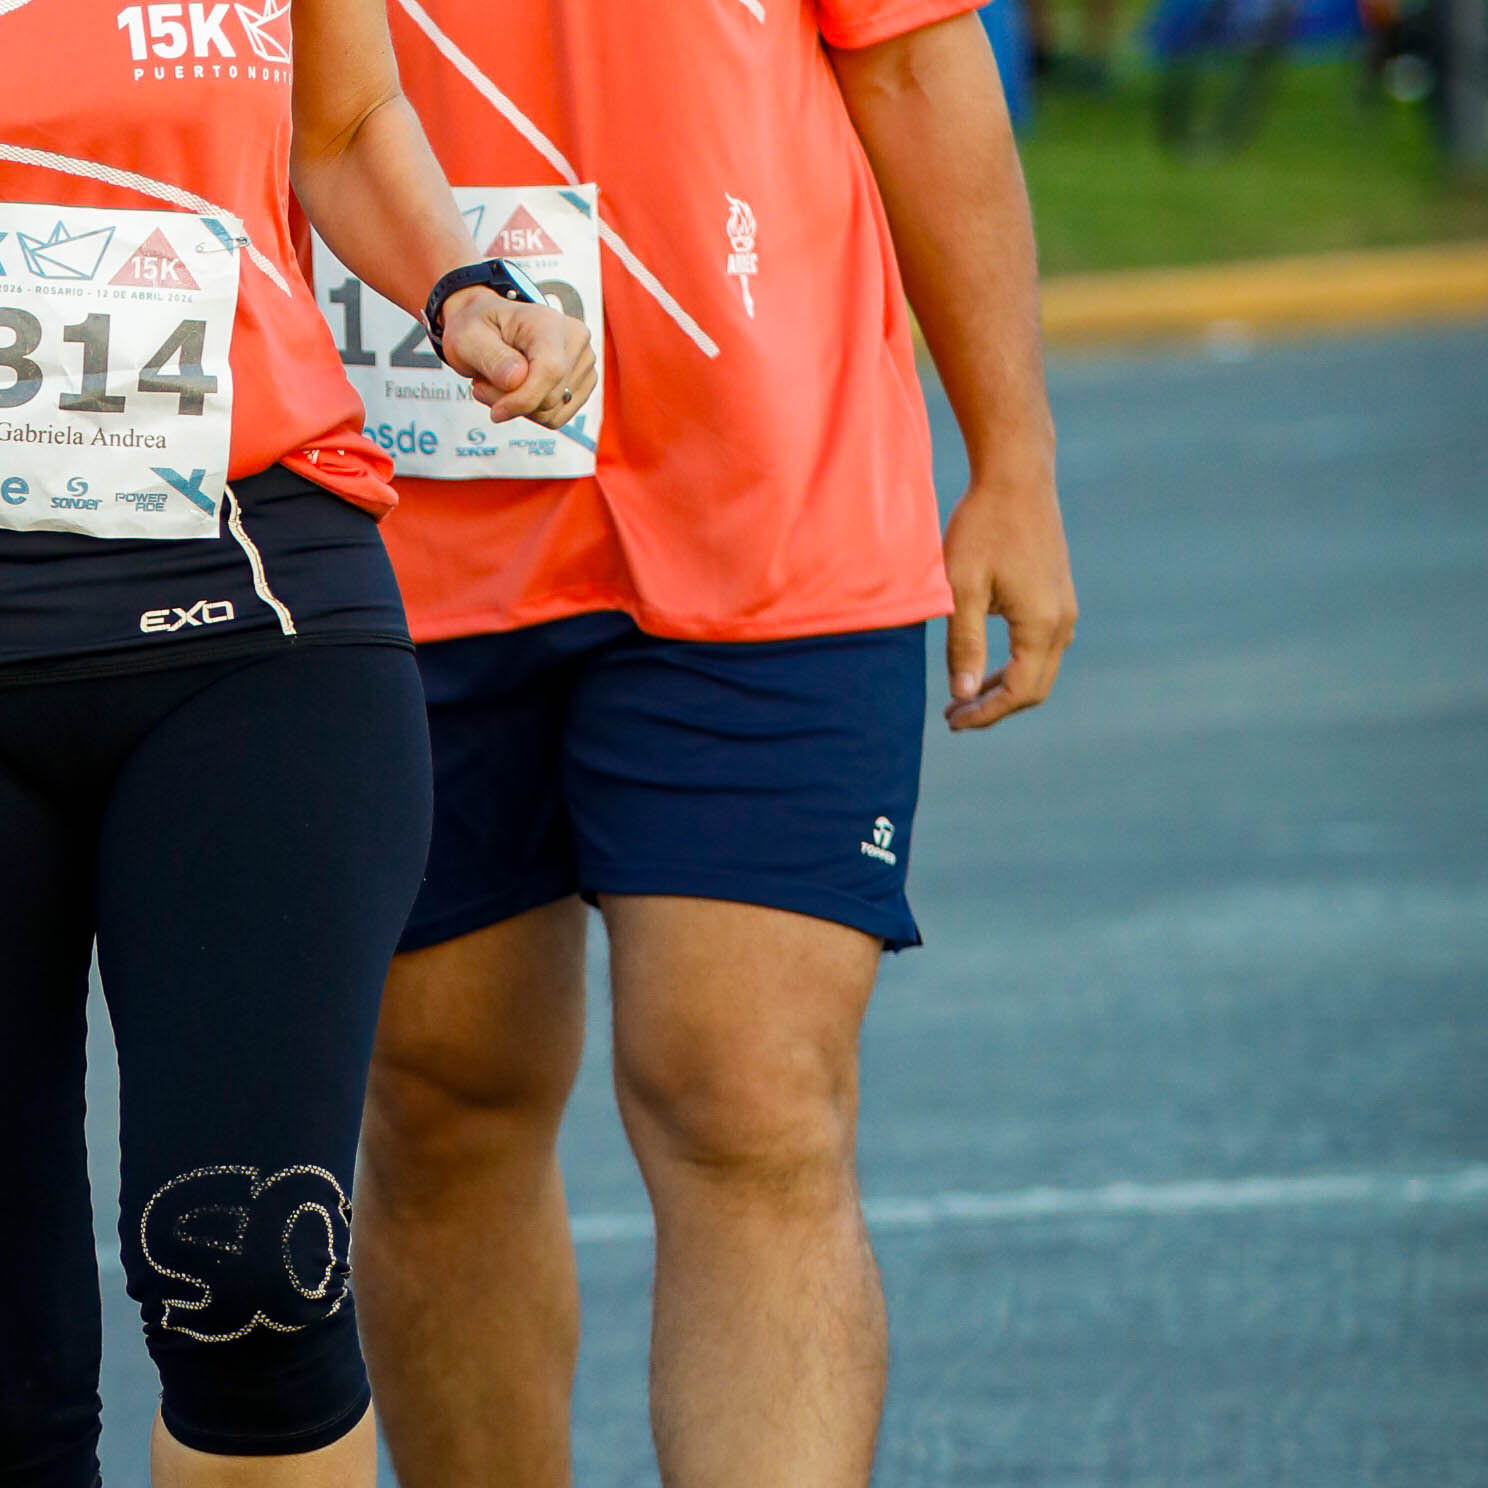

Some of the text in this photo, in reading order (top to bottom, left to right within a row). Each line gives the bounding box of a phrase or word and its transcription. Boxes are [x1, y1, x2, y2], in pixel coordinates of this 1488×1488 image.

[116, 2, 237, 61] 15K
[133, 65, 239, 82] PUERTO
[498, 228, 543, 251] 15K
[130, 255, 180, 282] 15K
[35, 285, 84, 297] ROSARIO
[97, 288, 109, 299] 12
[113, 290, 127, 300] DE
[130, 291, 163, 302] ABRIL
[384, 380, 451, 401] Fanchini
[90, 425, 168, 450] Andrea
[115, 492, 169, 504] POWER
[139, 599, 235, 634] EXO
